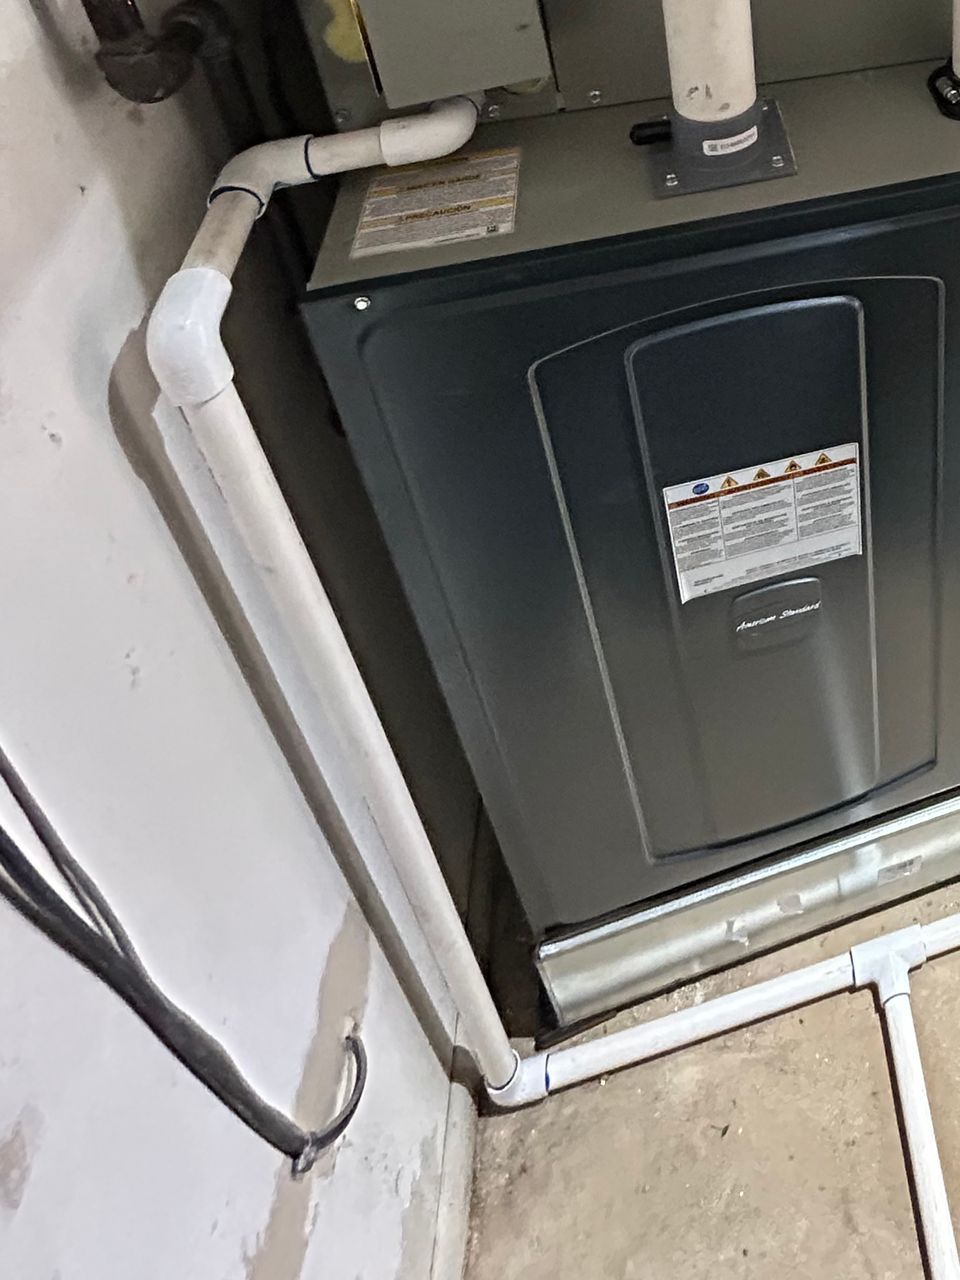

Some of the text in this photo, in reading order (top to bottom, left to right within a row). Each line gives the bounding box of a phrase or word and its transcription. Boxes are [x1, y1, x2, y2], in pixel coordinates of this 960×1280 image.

[405, 204, 471, 220] PRECAUCIÓN
[736, 600, 821, 632] American Standard
